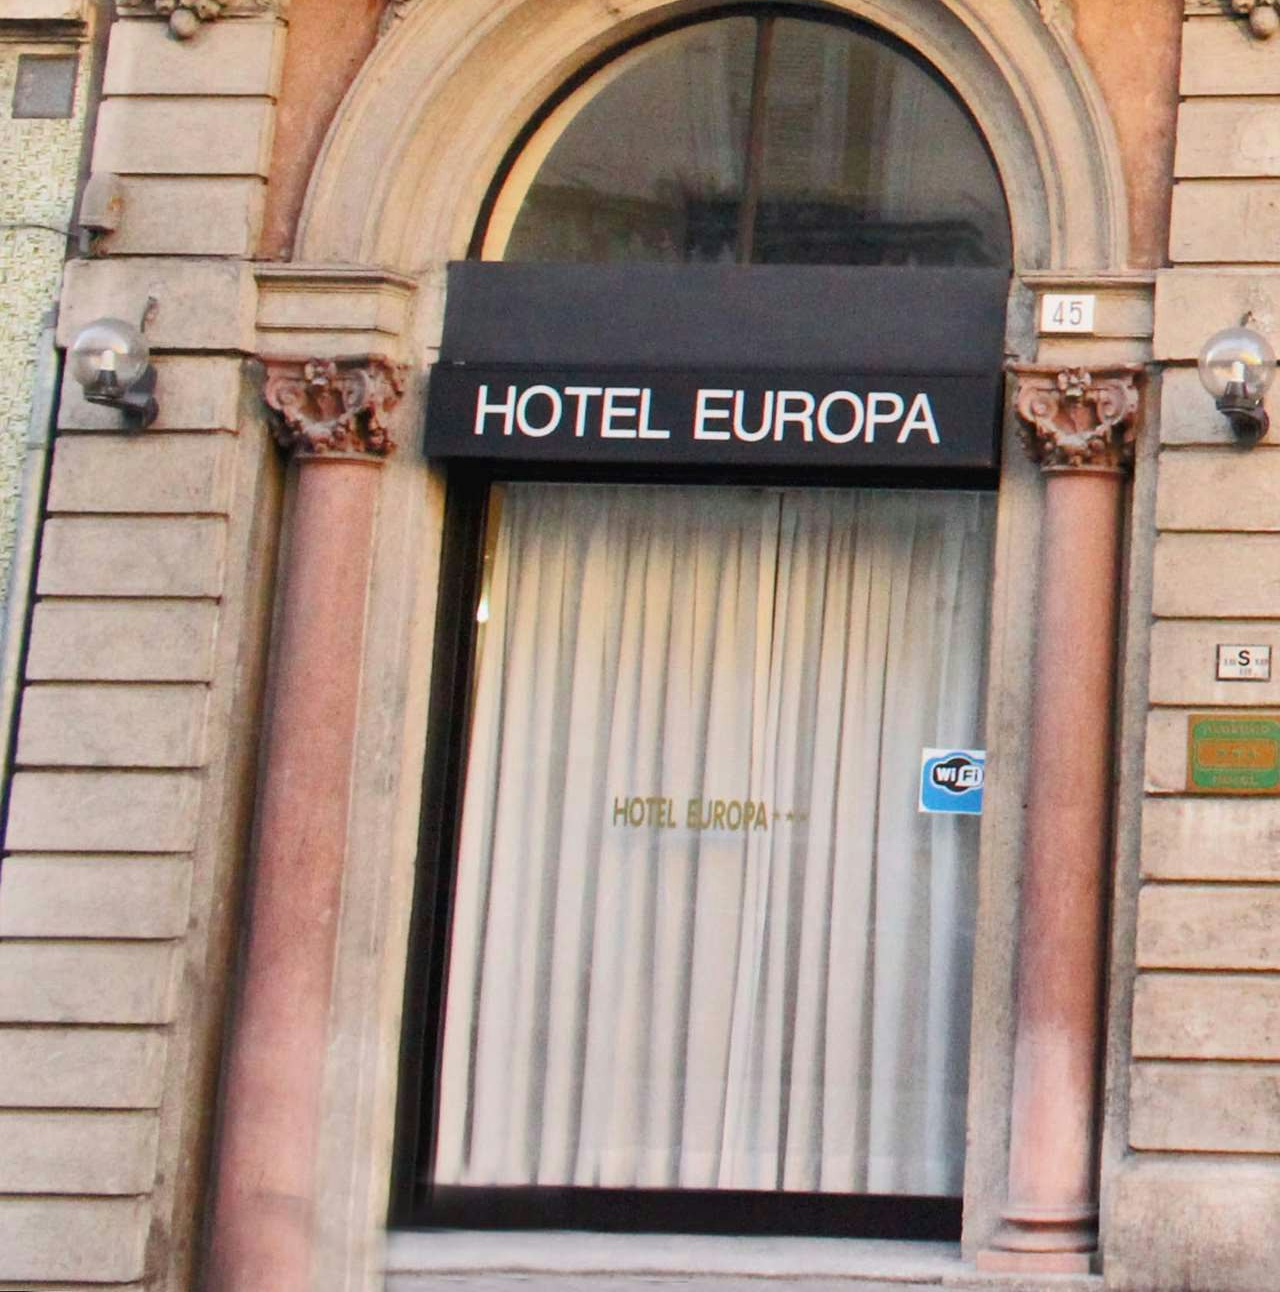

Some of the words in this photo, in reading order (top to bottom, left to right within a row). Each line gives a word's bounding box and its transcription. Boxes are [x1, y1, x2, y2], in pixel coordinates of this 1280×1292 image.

[1053, 299, 1083, 325] 45
[474, 384, 671, 439] HOTEL
[693, 388, 940, 444] EUROPA
[1238, 650, 1251, 667] S
[613, 796, 676, 827] HOTEL
[685, 798, 769, 831] EUROPA
